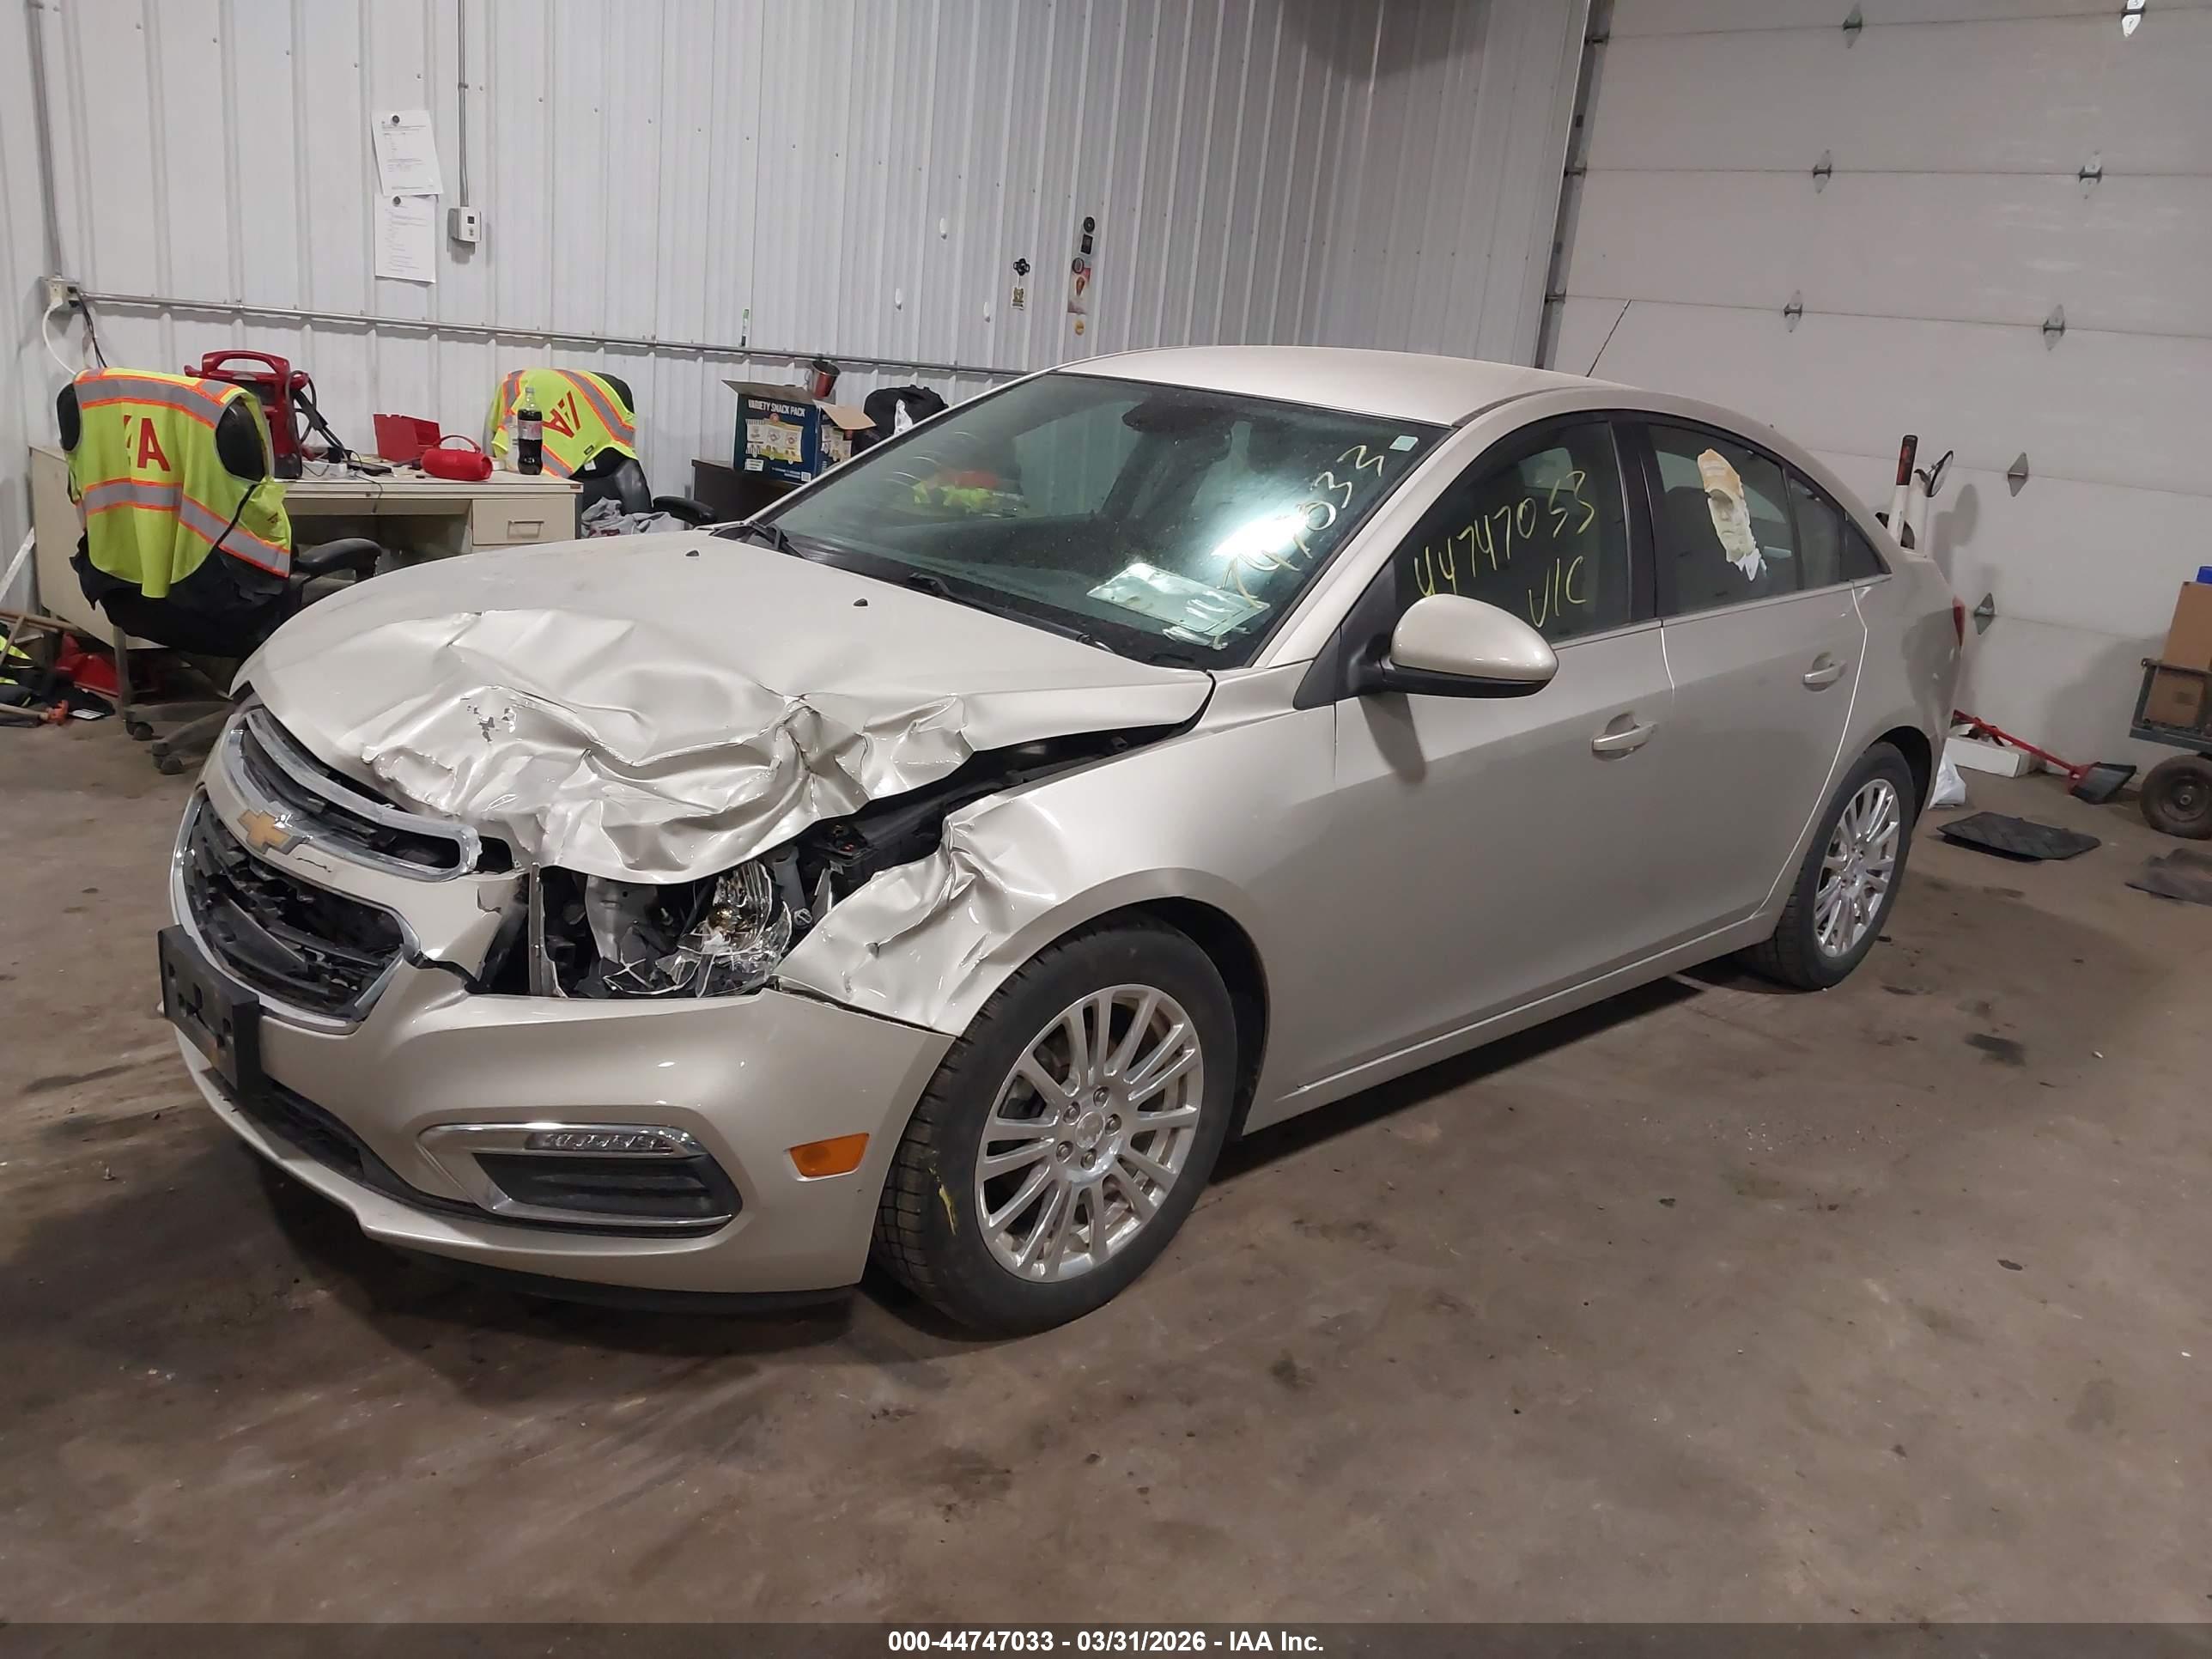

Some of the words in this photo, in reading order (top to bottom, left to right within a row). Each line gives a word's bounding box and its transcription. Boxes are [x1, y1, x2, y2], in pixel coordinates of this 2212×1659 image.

[748, 399, 770, 411] VARIETY
[770, 403, 790, 416] SNACK
[790, 405, 805, 417] PACK
